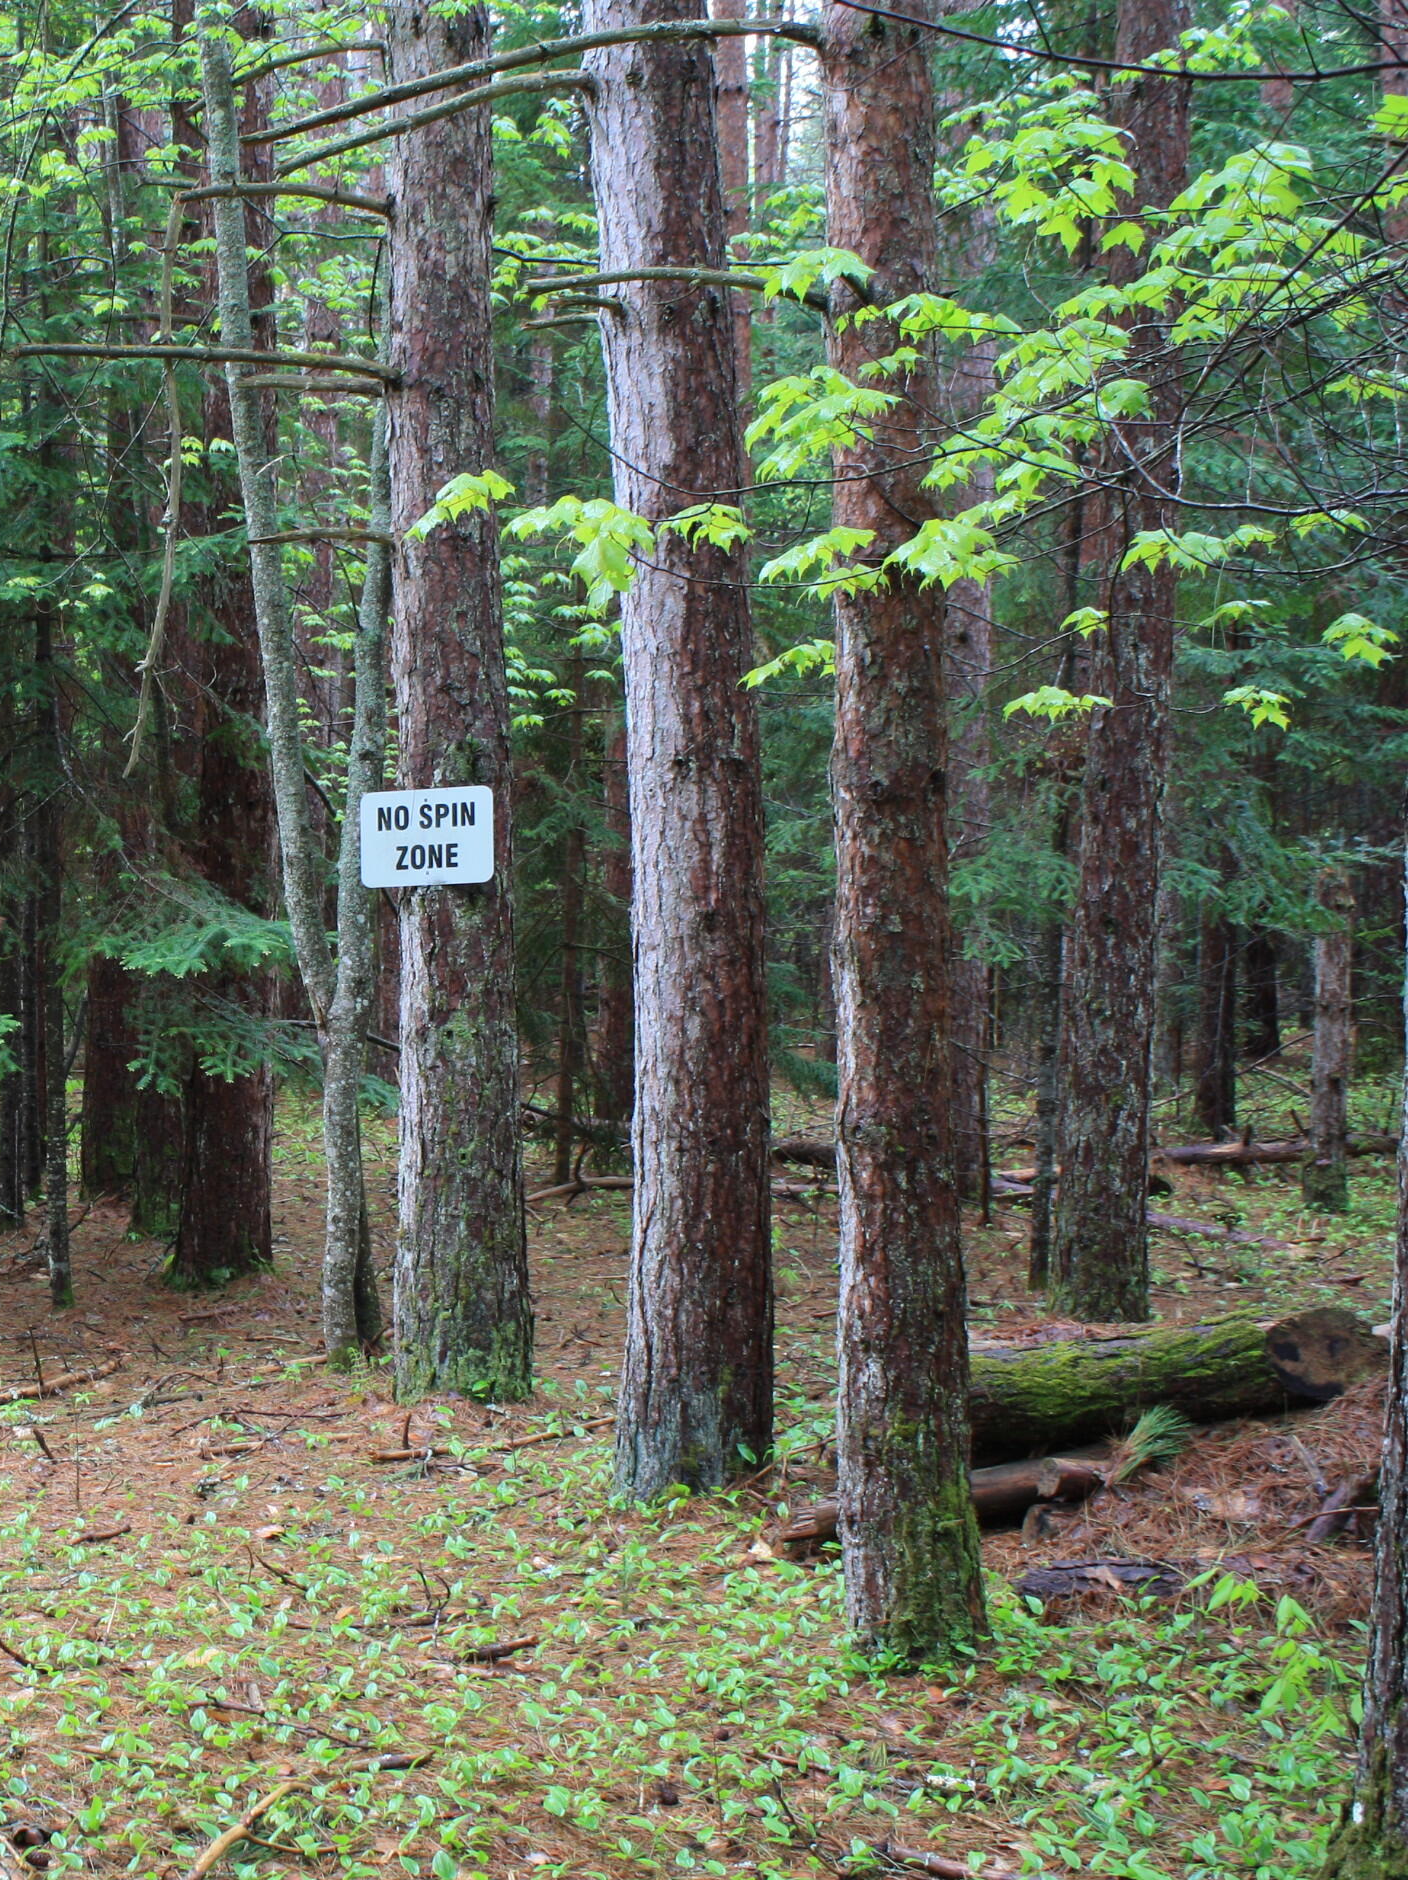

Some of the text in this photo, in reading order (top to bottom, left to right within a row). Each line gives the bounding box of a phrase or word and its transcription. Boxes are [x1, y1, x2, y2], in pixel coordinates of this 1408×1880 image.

[377, 801, 475, 831] NO SPIN
[395, 843, 459, 871] ZONE
